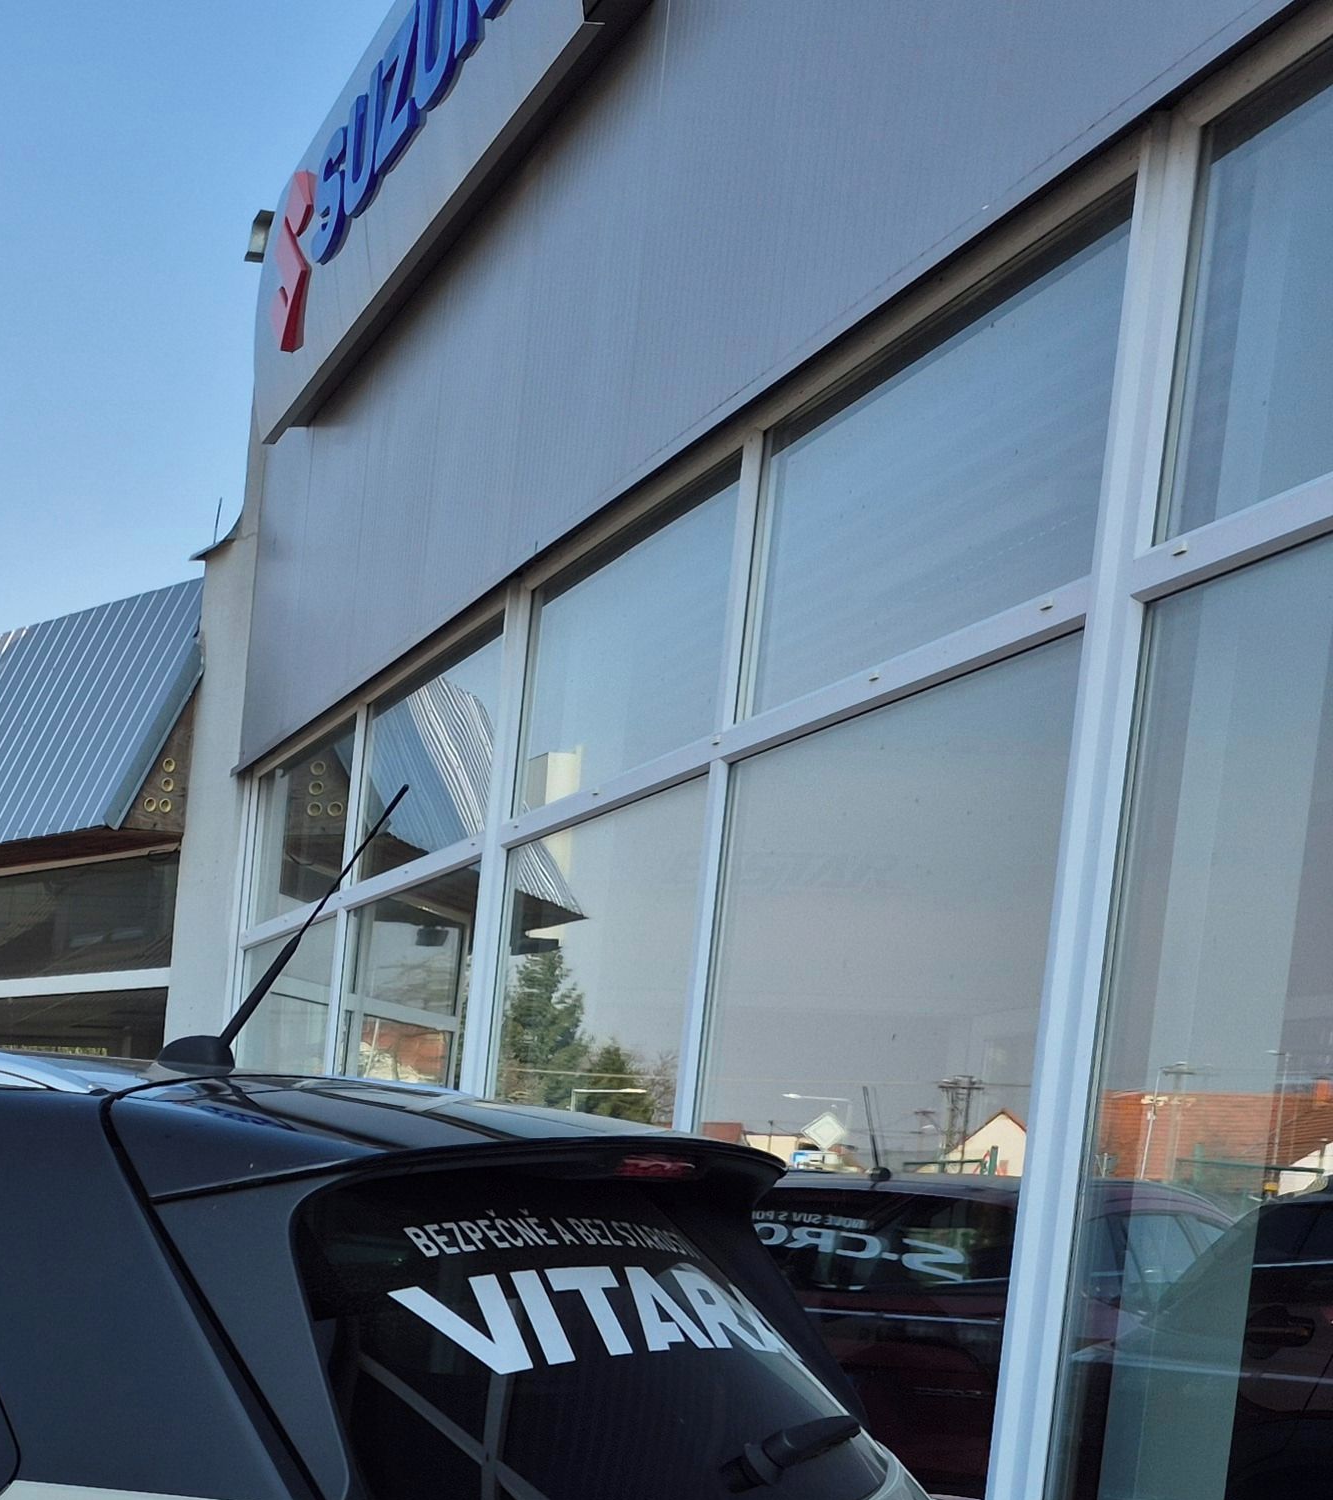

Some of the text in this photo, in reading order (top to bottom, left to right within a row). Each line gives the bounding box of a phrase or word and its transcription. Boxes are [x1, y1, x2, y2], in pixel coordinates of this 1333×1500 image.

[404, 1209, 559, 1257] BEZPEČNĚ
[558, 1217, 580, 1246] A
[572, 1217, 623, 1247] BEZ
